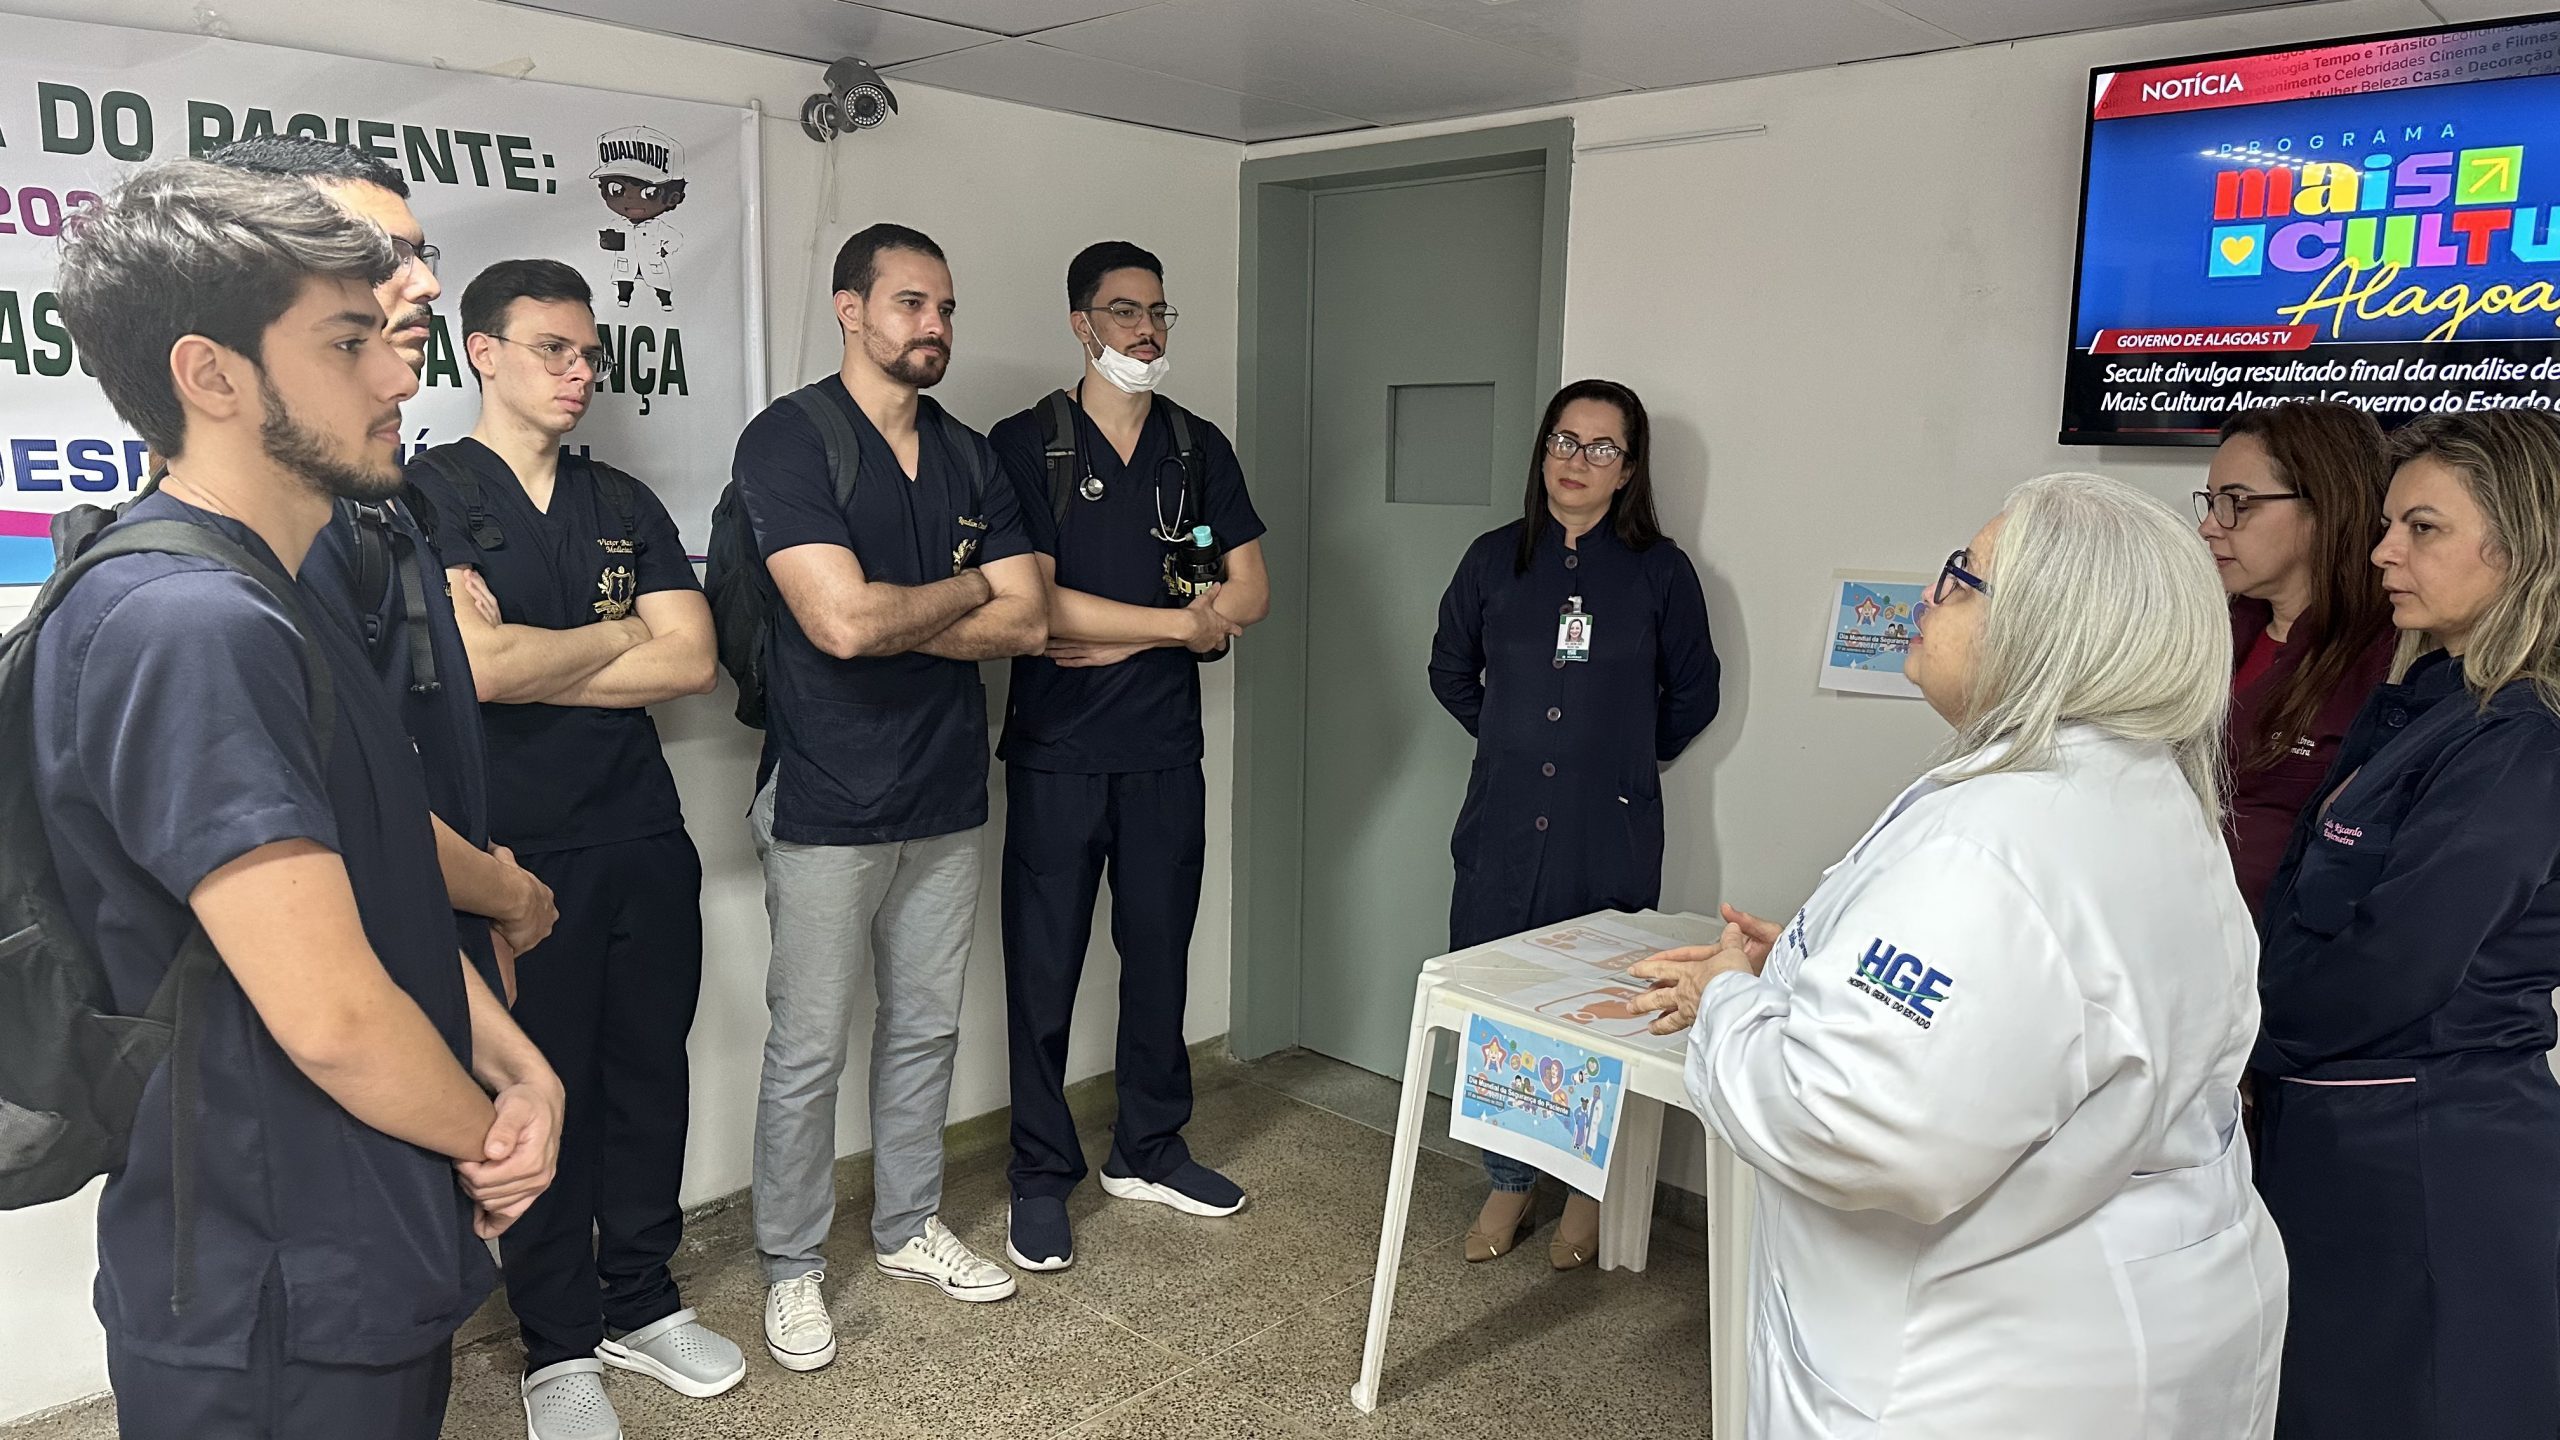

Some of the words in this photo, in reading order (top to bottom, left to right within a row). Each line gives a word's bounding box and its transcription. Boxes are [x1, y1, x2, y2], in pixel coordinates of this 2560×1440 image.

[2313, 52, 2360, 68] Tempo
[2364, 49, 2373, 59] e
[2377, 36, 2437, 56] Trânsito
[2334, 55, 2425, 81] Celebridades
[2430, 45, 2487, 63] Cinema
[2492, 42, 2501, 52] e
[2505, 31, 2558, 49] Filmes
[2361, 75, 2408, 92] Beleza
[2412, 67, 2450, 83] Casa
[2455, 65, 2463, 76] e
[2468, 48, 2553, 74] Decoração
[2141, 72, 2244, 102] NOTÍCIA
[38, 81, 154, 163] DO
[2220, 122, 2456, 156] PROGRAMA
[2276, 255, 2560, 343] Alagoa
[2117, 334, 2182, 348] GOVERNO
[2184, 332, 2202, 347] DE
[2202, 331, 2270, 346] ALAGOAS
[2272, 331, 2292, 345] TV
[2103, 361, 2163, 383] Secult
[2164, 361, 2241, 387] divulga
[2243, 359, 2347, 383] resultado
[2349, 358, 2405, 382] final
[2404, 358, 2437, 381] da
[2439, 356, 2528, 381] análise
[2530, 356, 2560, 380] de
[2100, 391, 2149, 412] Mais
[2150, 391, 2224, 412] Cultura
[2429, 389, 2459, 413] do
[2466, 389, 2550, 412] Estado
[1854, 936, 1954, 1019] HGE
[1871, 989, 1892, 1006] GERAL
[1891, 1001, 1904, 1012] DO
[1903, 1007, 1931, 1030] ESTADO
